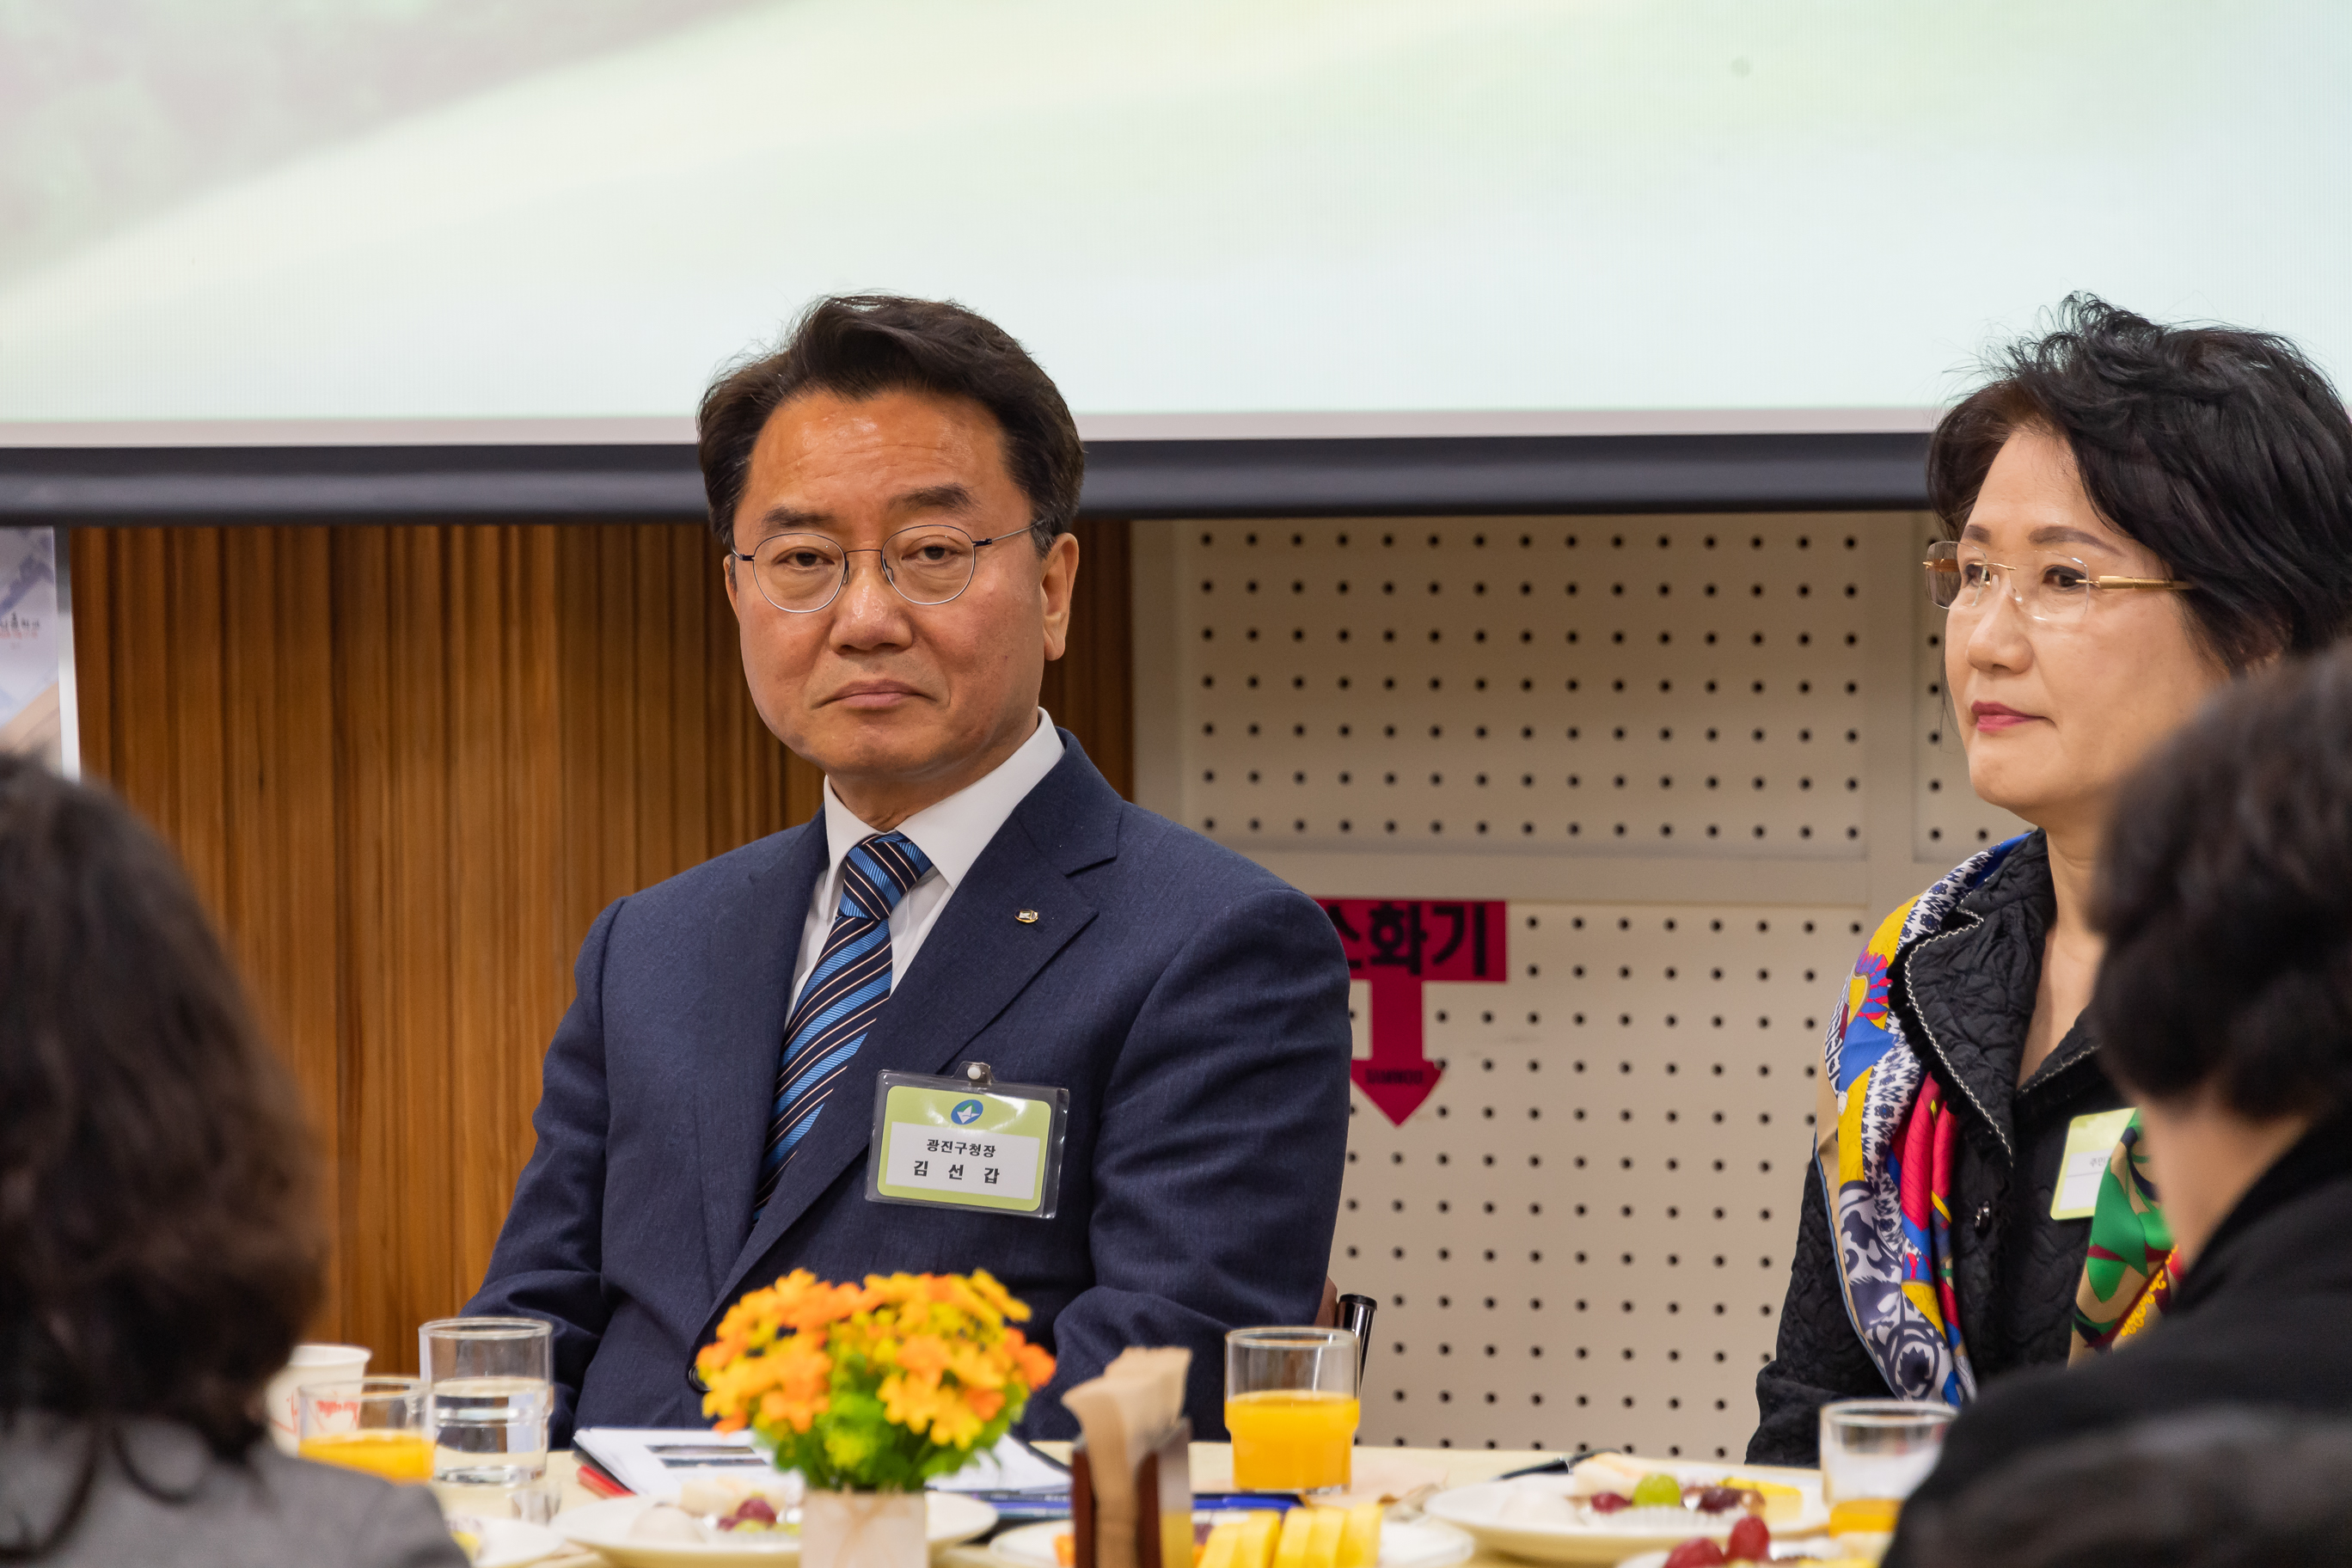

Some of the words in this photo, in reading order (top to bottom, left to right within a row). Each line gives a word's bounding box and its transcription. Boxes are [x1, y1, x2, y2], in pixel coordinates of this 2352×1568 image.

[927, 1138, 995, 1158] 광진구청장
[914, 1161, 928, 1177] 김
[948, 1164, 964, 1180] 선
[983, 1167, 1000, 1185] 갑
